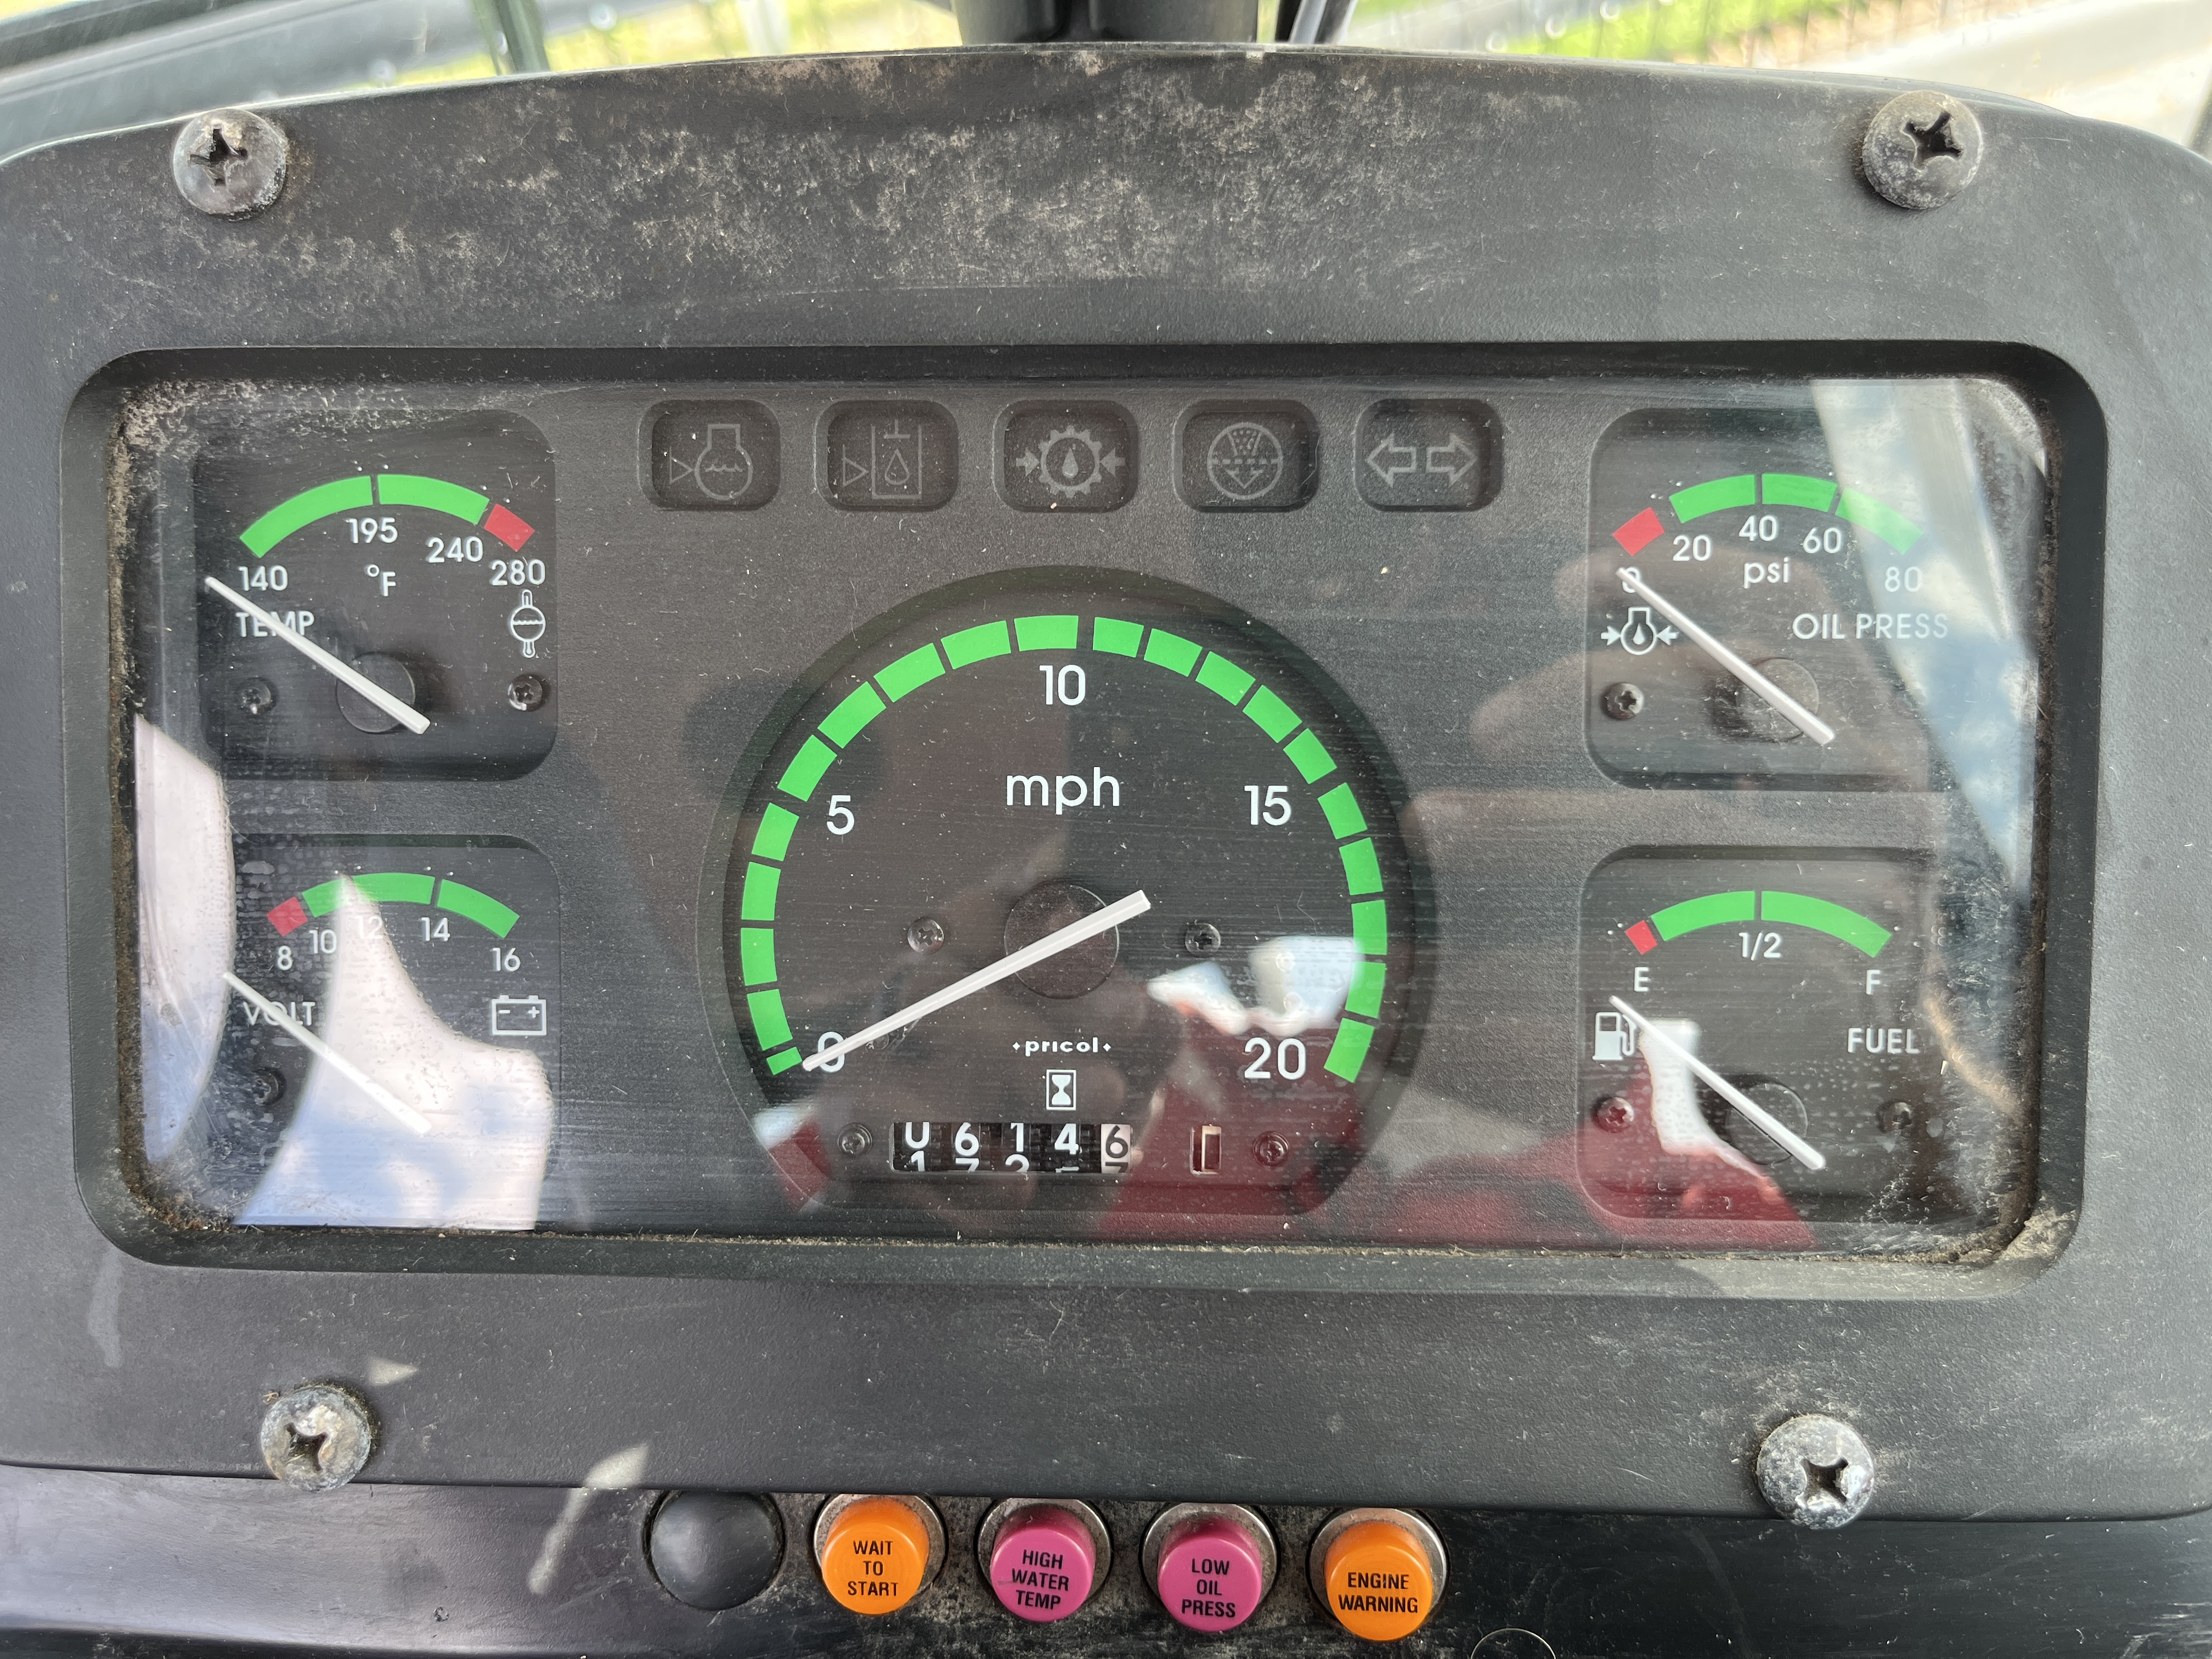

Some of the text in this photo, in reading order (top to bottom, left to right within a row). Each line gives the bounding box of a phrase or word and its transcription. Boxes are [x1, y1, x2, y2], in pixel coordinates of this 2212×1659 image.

[348, 517, 398, 544] 195
[1739, 516, 1779, 541] 40
[1803, 527, 1842, 554] 60
[427, 537, 483, 563] 240
[1673, 535, 1712, 561] 20
[239, 566, 288, 591] 140
[492, 560, 545, 586] 280
[1744, 557, 1790, 589] psi
[1884, 567, 1923, 592] 80
[235, 610, 314, 637] TEMP
[1792, 613, 1948, 639] OIL PRESS
[1039, 664, 1086, 706] 10
[1006, 766, 1120, 815] mph
[826, 795, 855, 836] 5
[1244, 785, 1292, 826] 15
[354, 915, 383, 940] 12
[421, 917, 450, 941] 14
[309, 929, 337, 953] 10
[1739, 933, 1782, 961] 1/2
[277, 946, 292, 970] 8
[492, 947, 521, 972] 16
[1634, 967, 1649, 992] E
[1865, 969, 1881, 995] F
[243, 1001, 315, 1026] VOLT
[817, 1031, 845, 1073] 0
[1025, 1037, 1098, 1057] pricol
[1848, 1028, 1919, 1054] FUEL
[1244, 1037, 1306, 1080] 20
[853, 1540, 893, 1556] WAIT
[1023, 1549, 1063, 1570] HIGH
[863, 1560, 883, 1576] TO
[1191, 1558, 1230, 1575] LOW
[847, 1581, 899, 1596] START
[1012, 1568, 1069, 1592] WATER
[1197, 1578, 1222, 1596] OIL
[1347, 1572, 1409, 1590] ENGINE
[1015, 1590, 1061, 1610] TEMP
[1181, 1599, 1236, 1618] PRESS
[1338, 1594, 1419, 1613] WARNING
